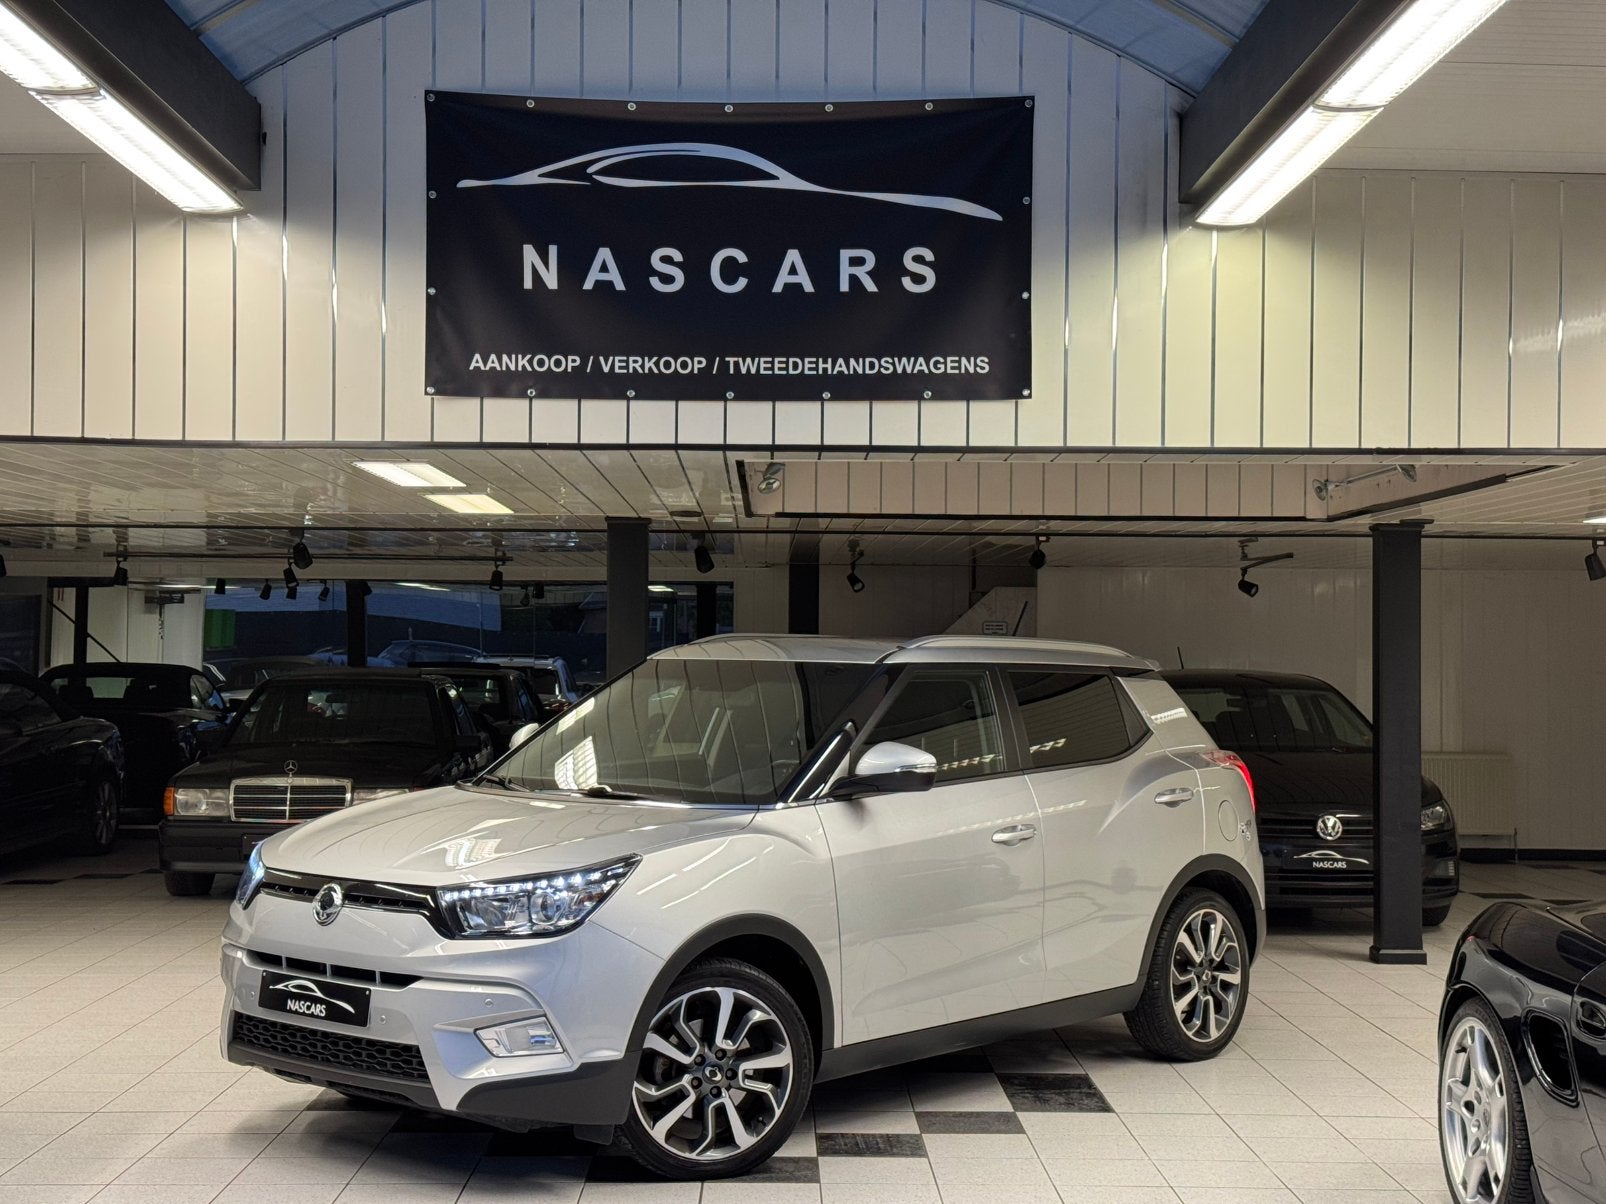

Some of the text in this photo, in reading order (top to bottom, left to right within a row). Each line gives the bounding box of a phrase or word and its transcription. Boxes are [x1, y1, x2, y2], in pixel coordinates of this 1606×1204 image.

[522, 244, 937, 294] NASCARS
[468, 352, 581, 373] AANKOOP
[598, 356, 707, 375] VERKOOP
[724, 356, 990, 375] TWEEDEHANDSWAGENS
[1312, 860, 1347, 869] NASCARS
[286, 998, 327, 1017] NASCARS
